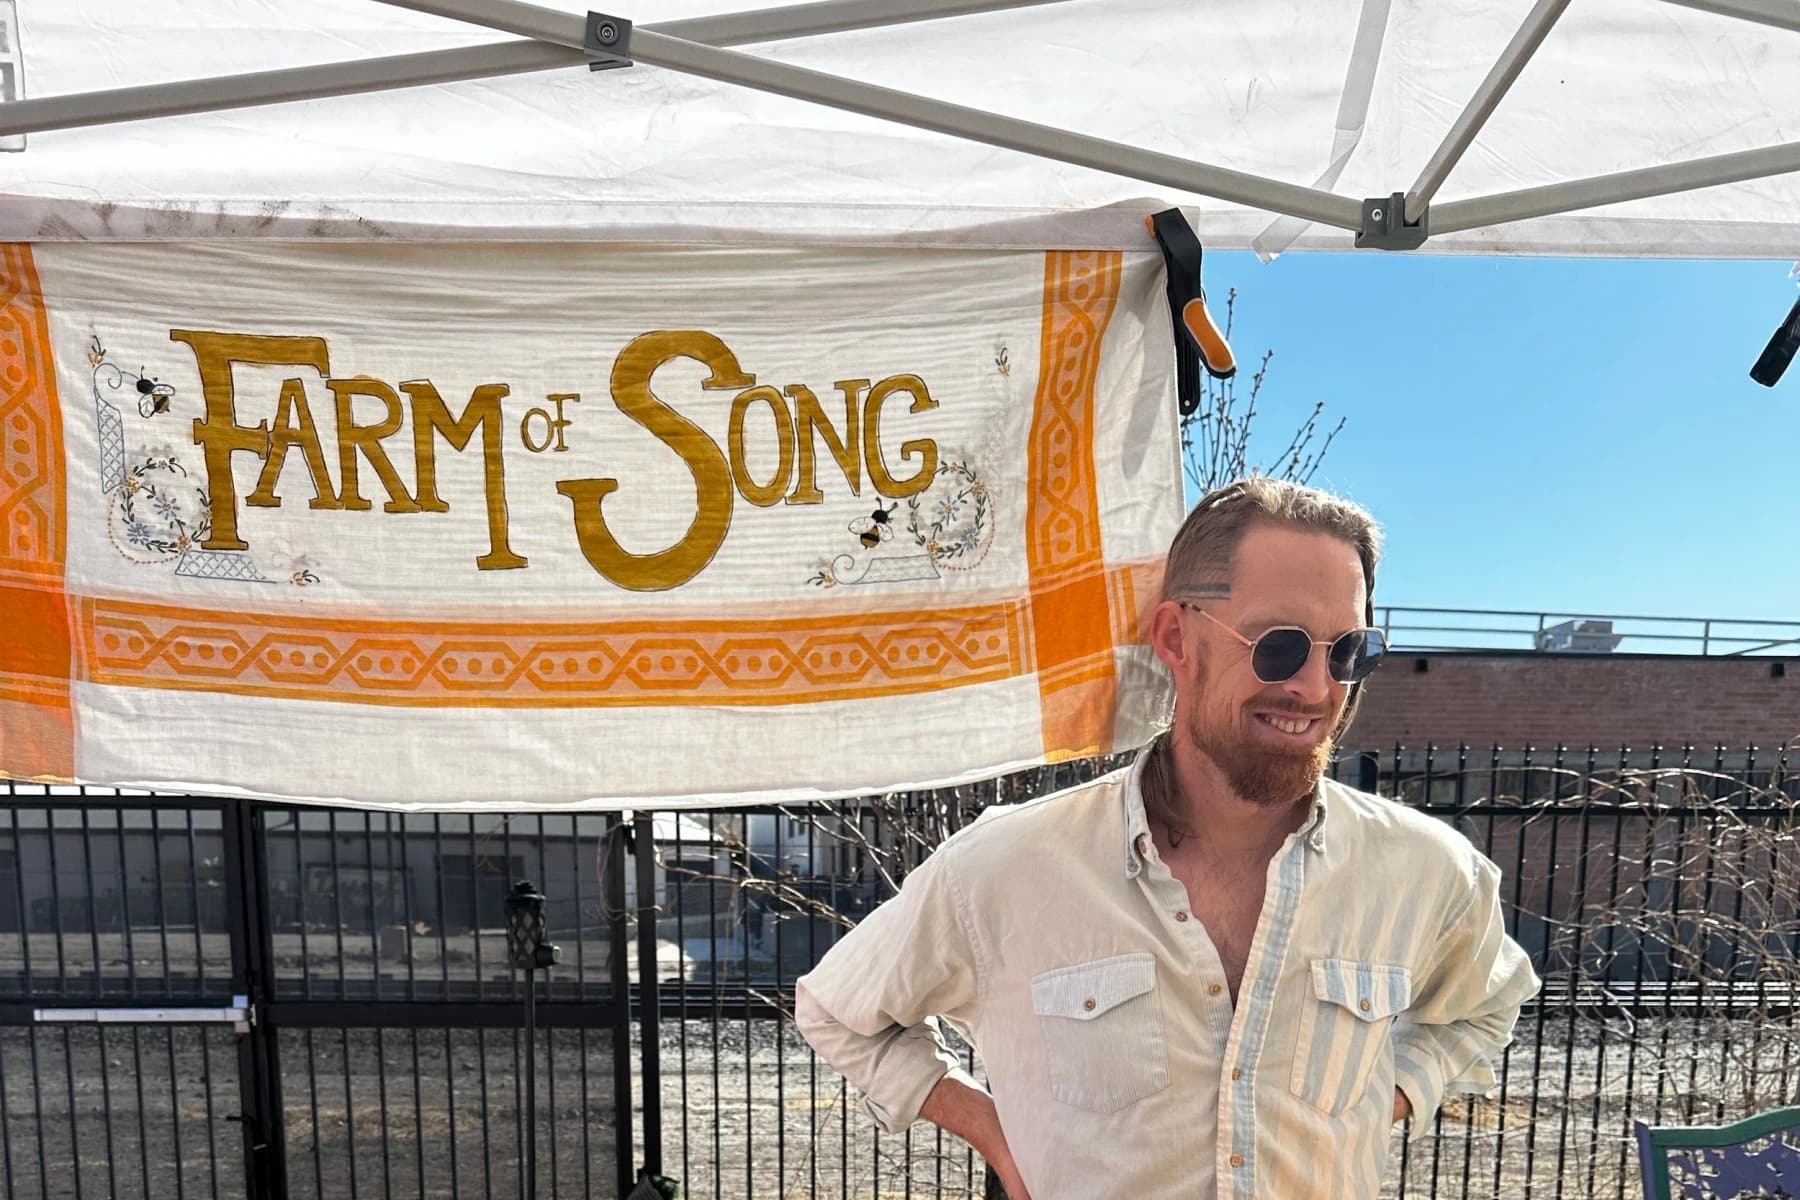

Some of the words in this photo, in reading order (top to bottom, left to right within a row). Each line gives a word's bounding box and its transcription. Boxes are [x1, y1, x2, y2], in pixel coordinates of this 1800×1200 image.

[170, 328, 529, 571] FARM
[520, 393, 581, 453] OF
[555, 329, 940, 592] SONG
